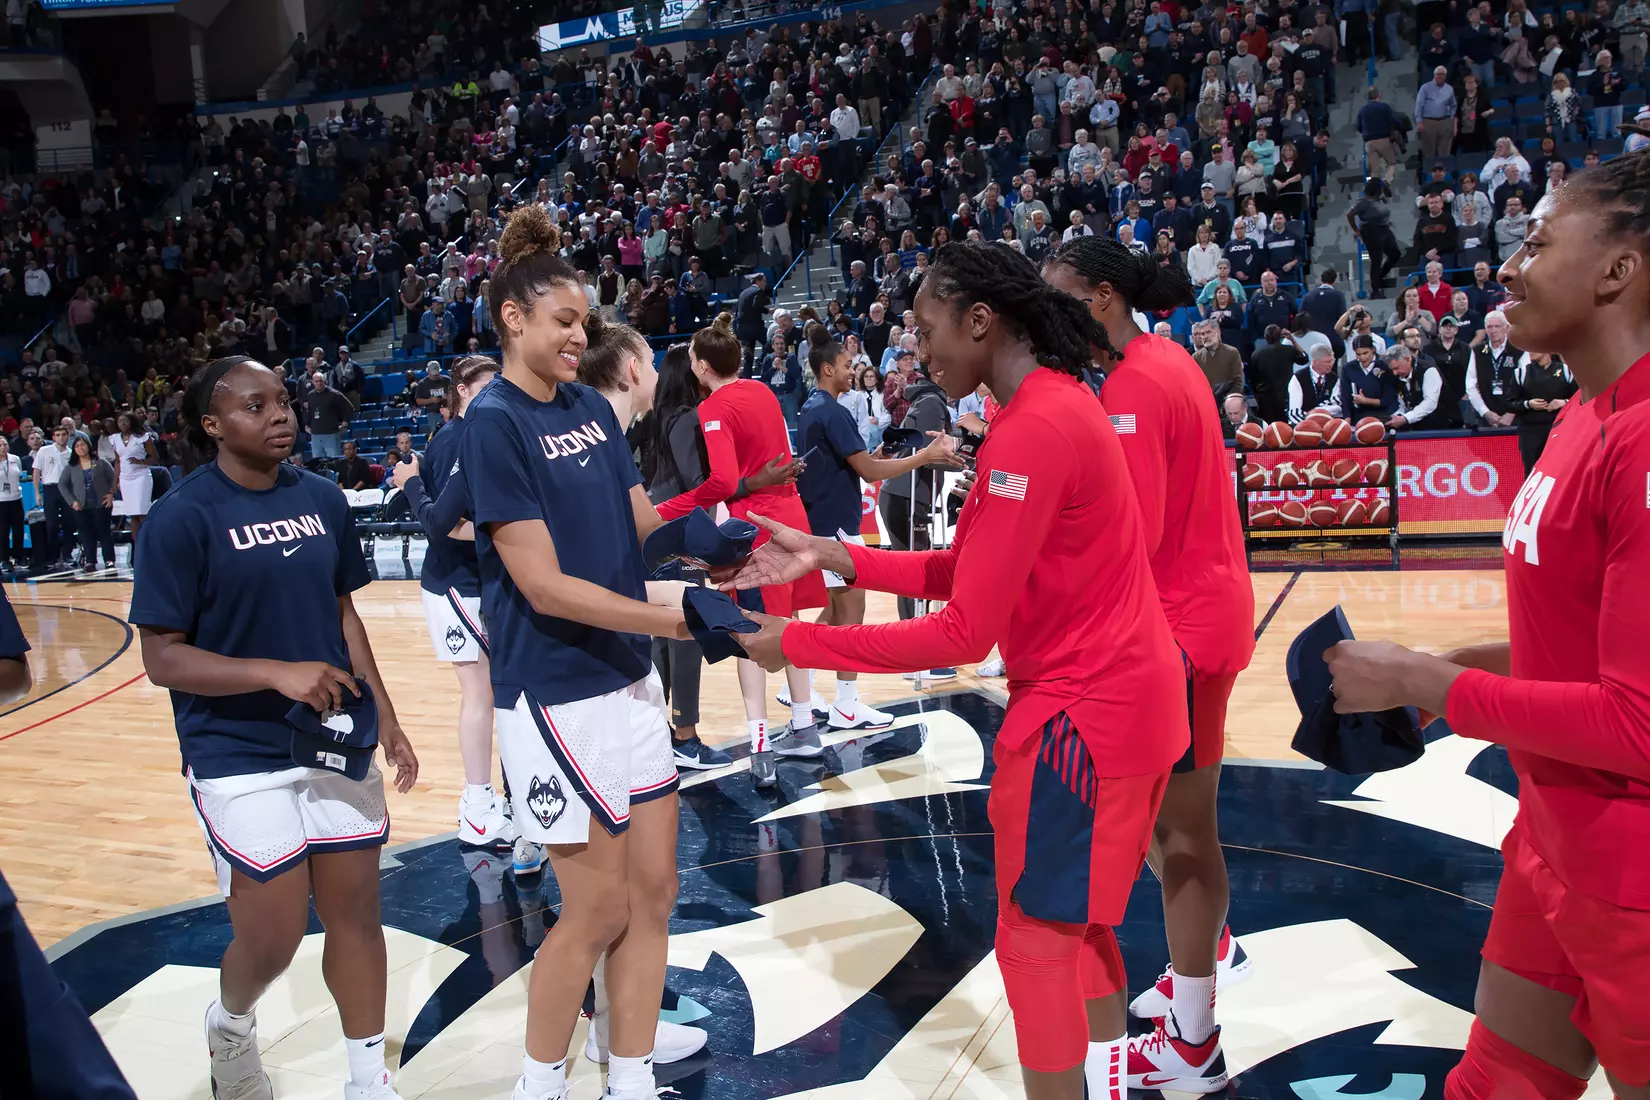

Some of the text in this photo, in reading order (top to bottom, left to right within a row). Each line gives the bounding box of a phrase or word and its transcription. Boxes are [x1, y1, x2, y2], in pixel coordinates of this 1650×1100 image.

[821, 6, 842, 20] 114
[50, 121, 72, 132] 112
[538, 420, 608, 460] UCONN
[229, 513, 327, 551] UCONN
